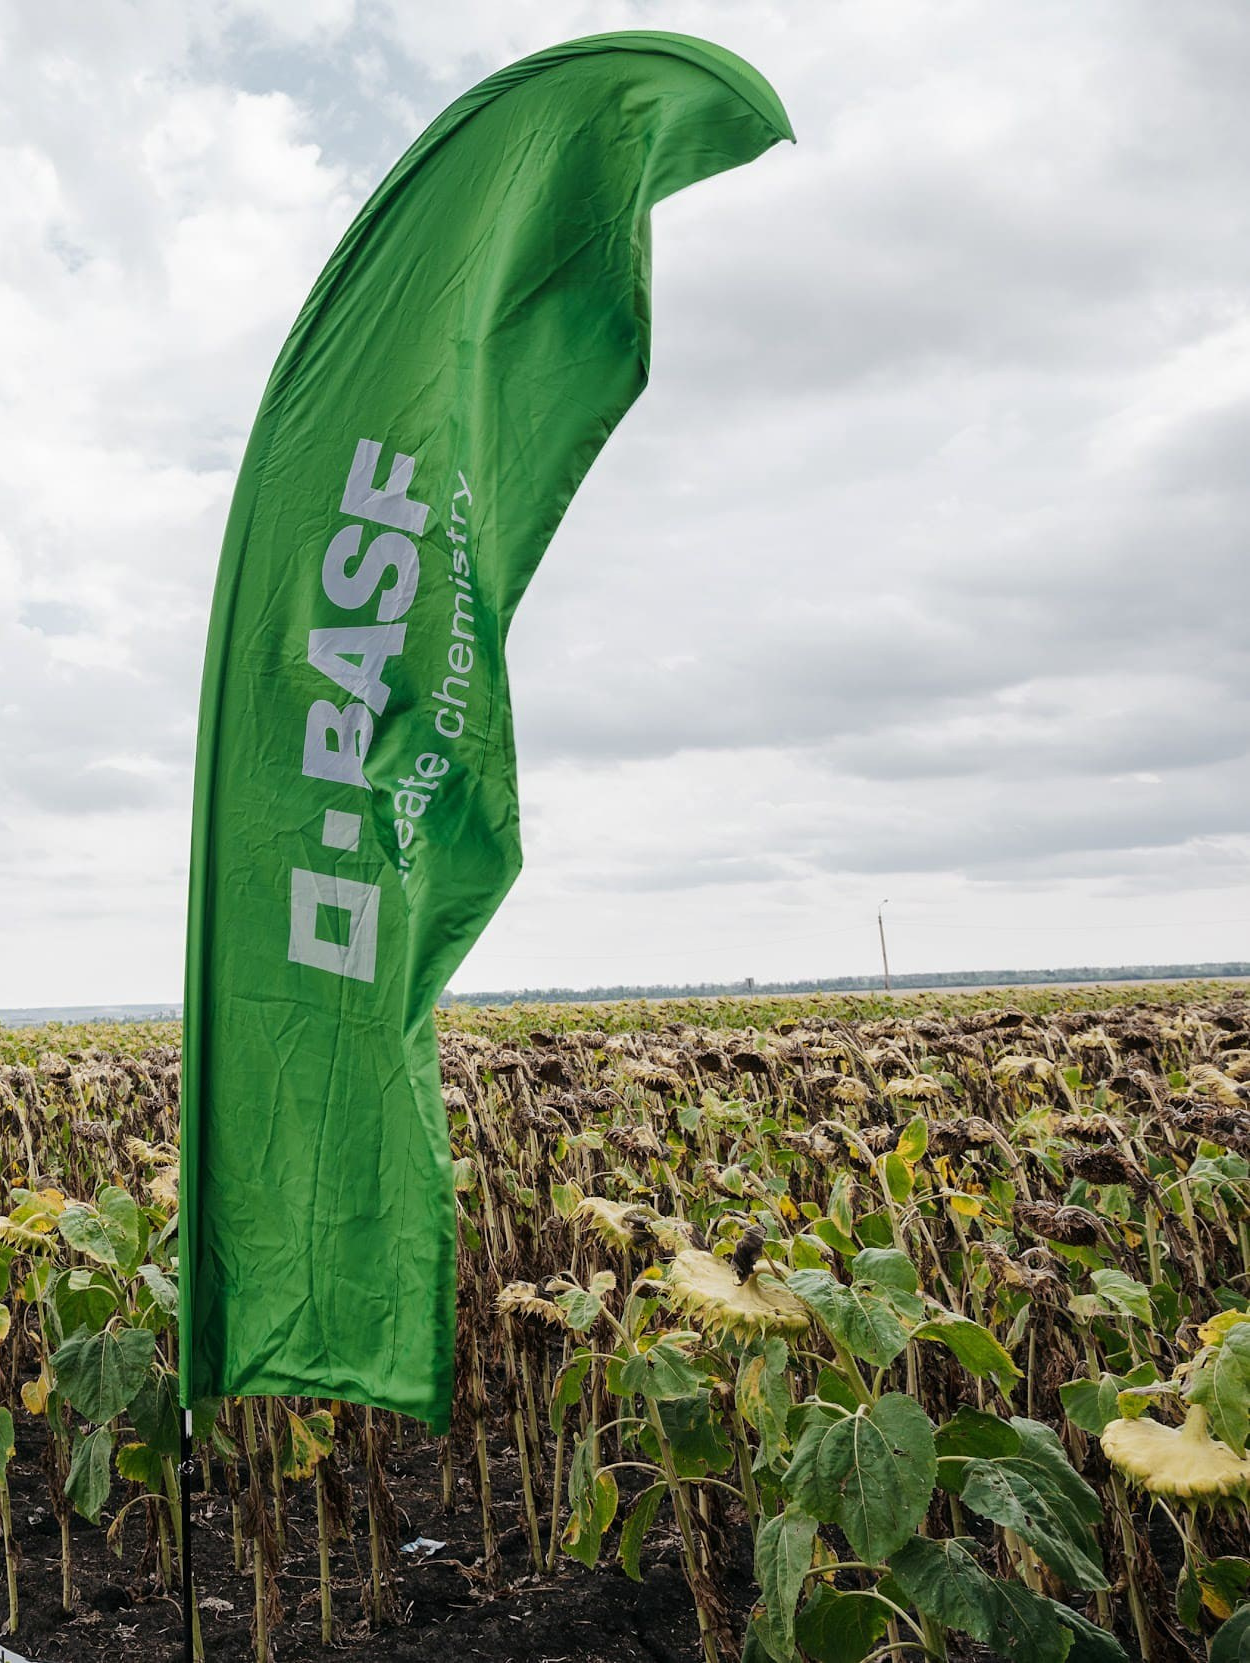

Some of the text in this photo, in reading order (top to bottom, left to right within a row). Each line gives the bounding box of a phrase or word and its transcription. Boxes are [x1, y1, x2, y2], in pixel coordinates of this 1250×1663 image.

[302, 438, 431, 791] BASF
[393, 470, 475, 887] eate chemistry
